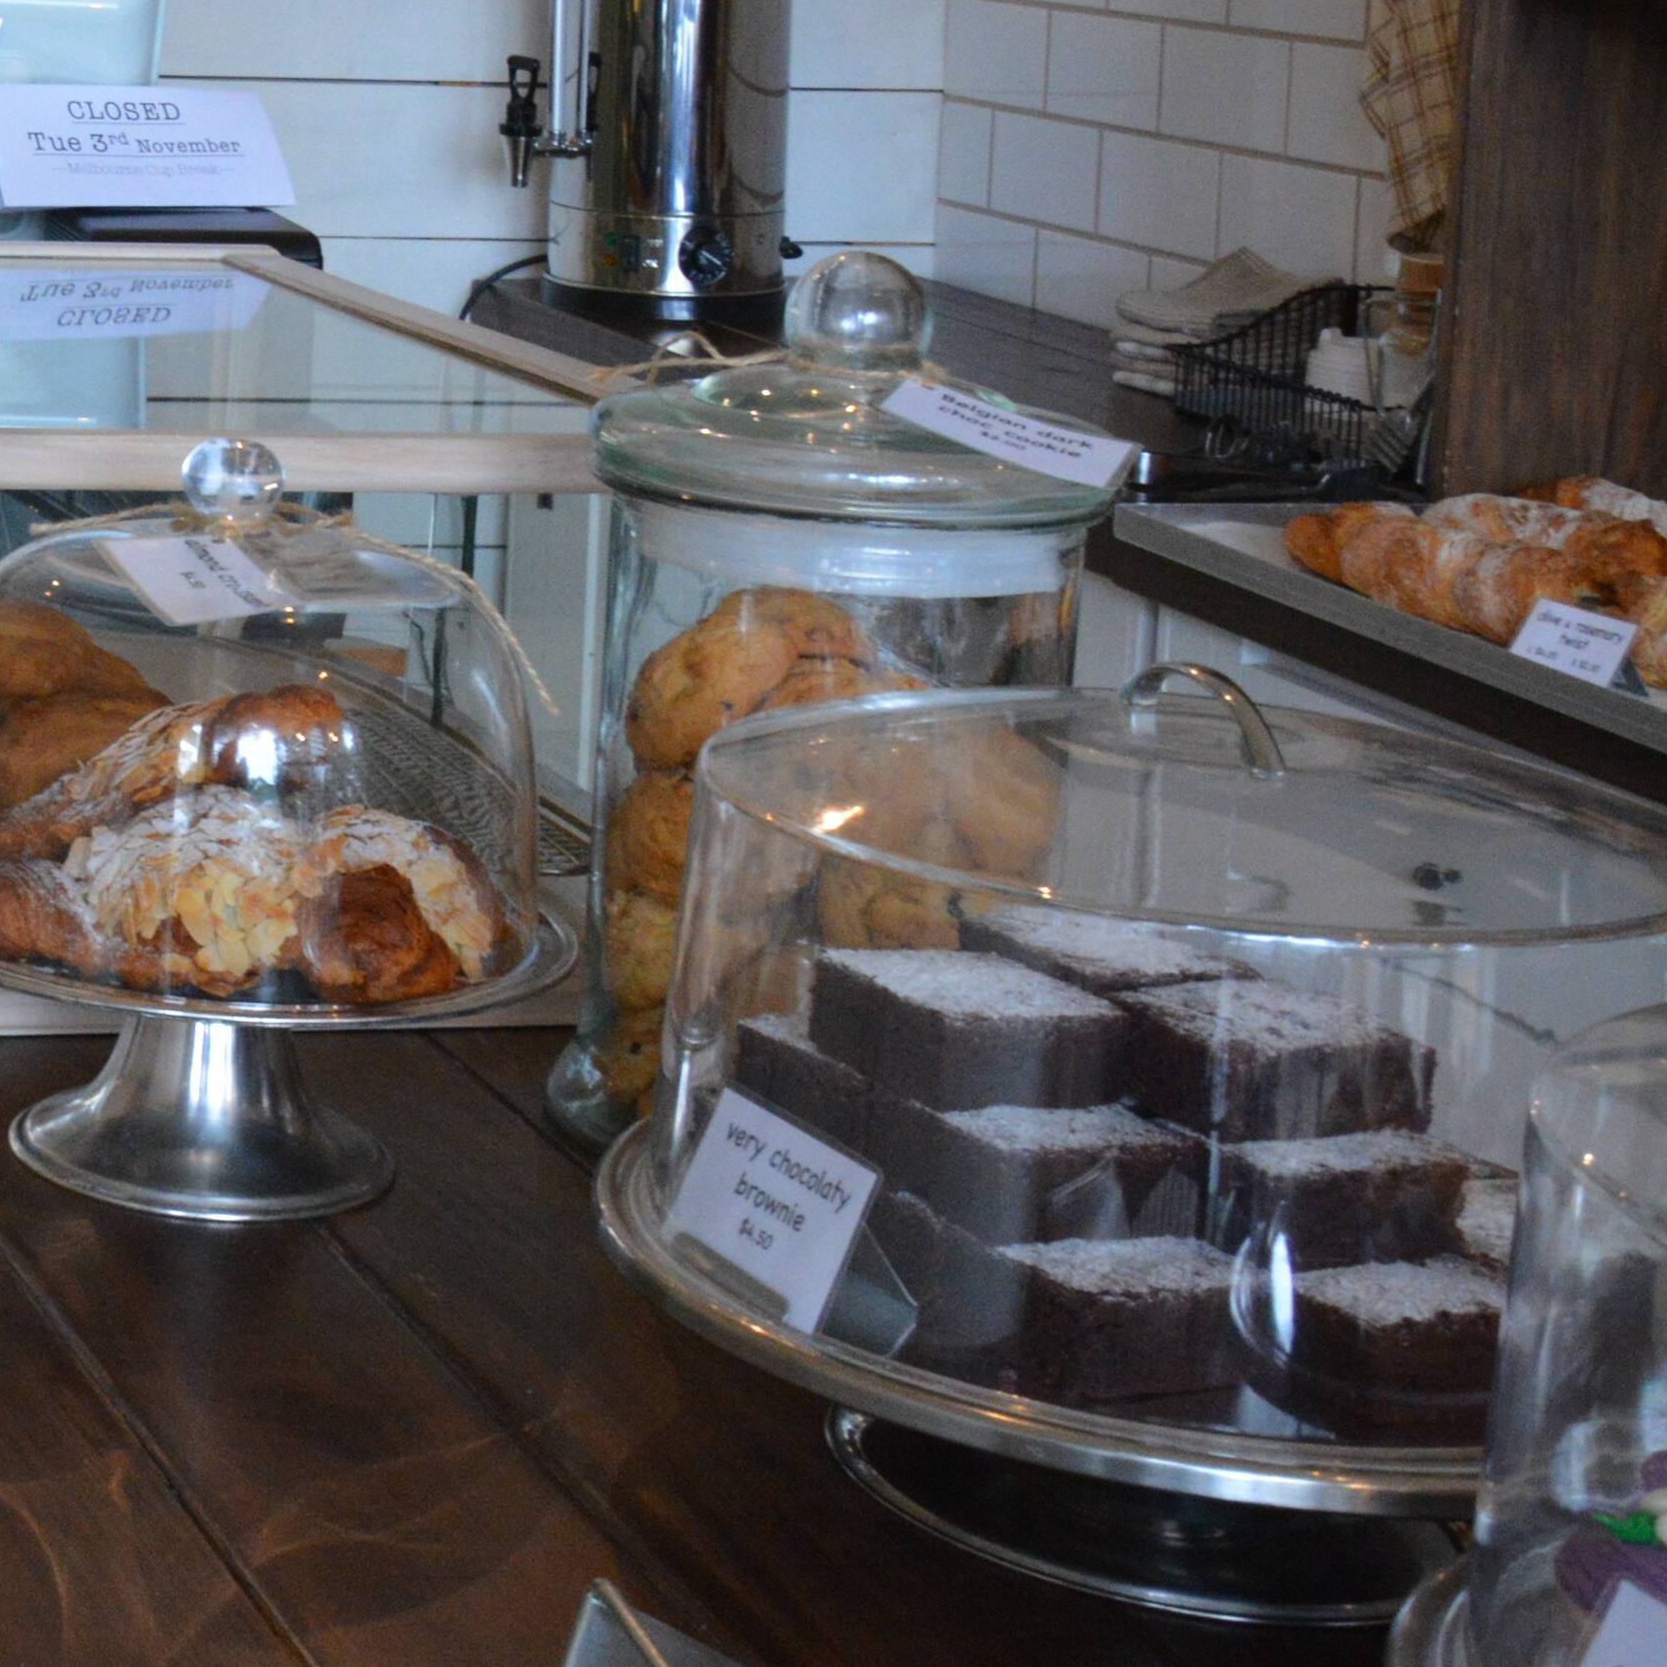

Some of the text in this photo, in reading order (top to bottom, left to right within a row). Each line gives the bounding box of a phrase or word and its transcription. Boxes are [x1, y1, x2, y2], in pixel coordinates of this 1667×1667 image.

[66, 100, 182, 122] CLOSED
[27, 131, 241, 154] Tue 3rd November
[938, 404, 1083, 458] choc cookie
[940, 392, 1093, 450] Belgian dark
[725, 1122, 853, 1215] very chocolaty
[733, 1172, 807, 1233] brownie
